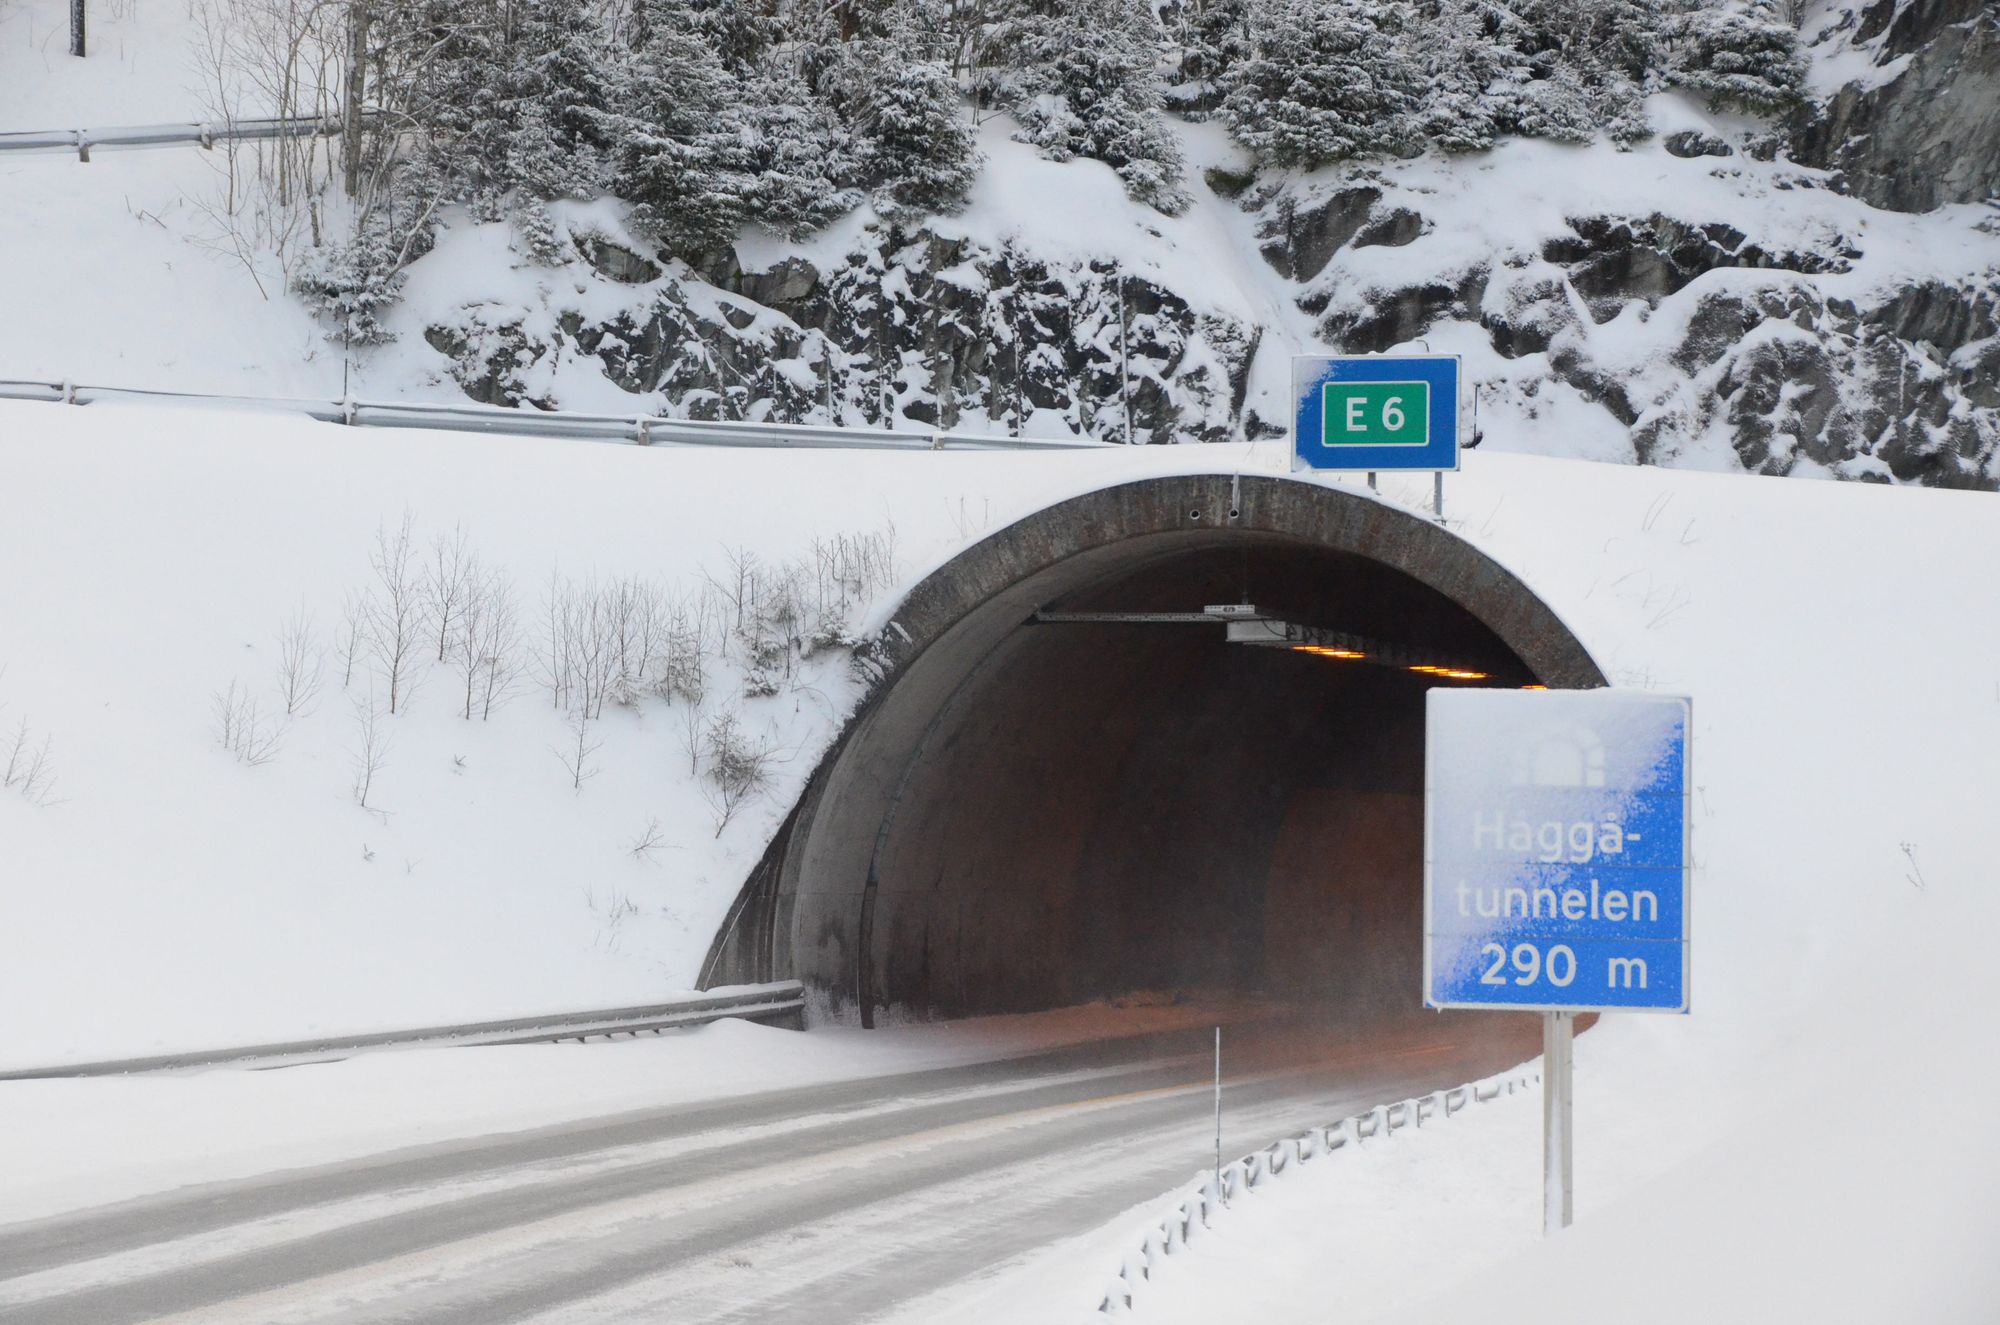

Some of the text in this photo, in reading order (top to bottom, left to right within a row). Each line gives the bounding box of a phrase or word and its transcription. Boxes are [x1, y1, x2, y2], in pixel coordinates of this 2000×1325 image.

[1346, 397, 1405, 431] E 6
[1456, 880, 1658, 921] tunnelen
[1480, 943, 1648, 988] 290 m
